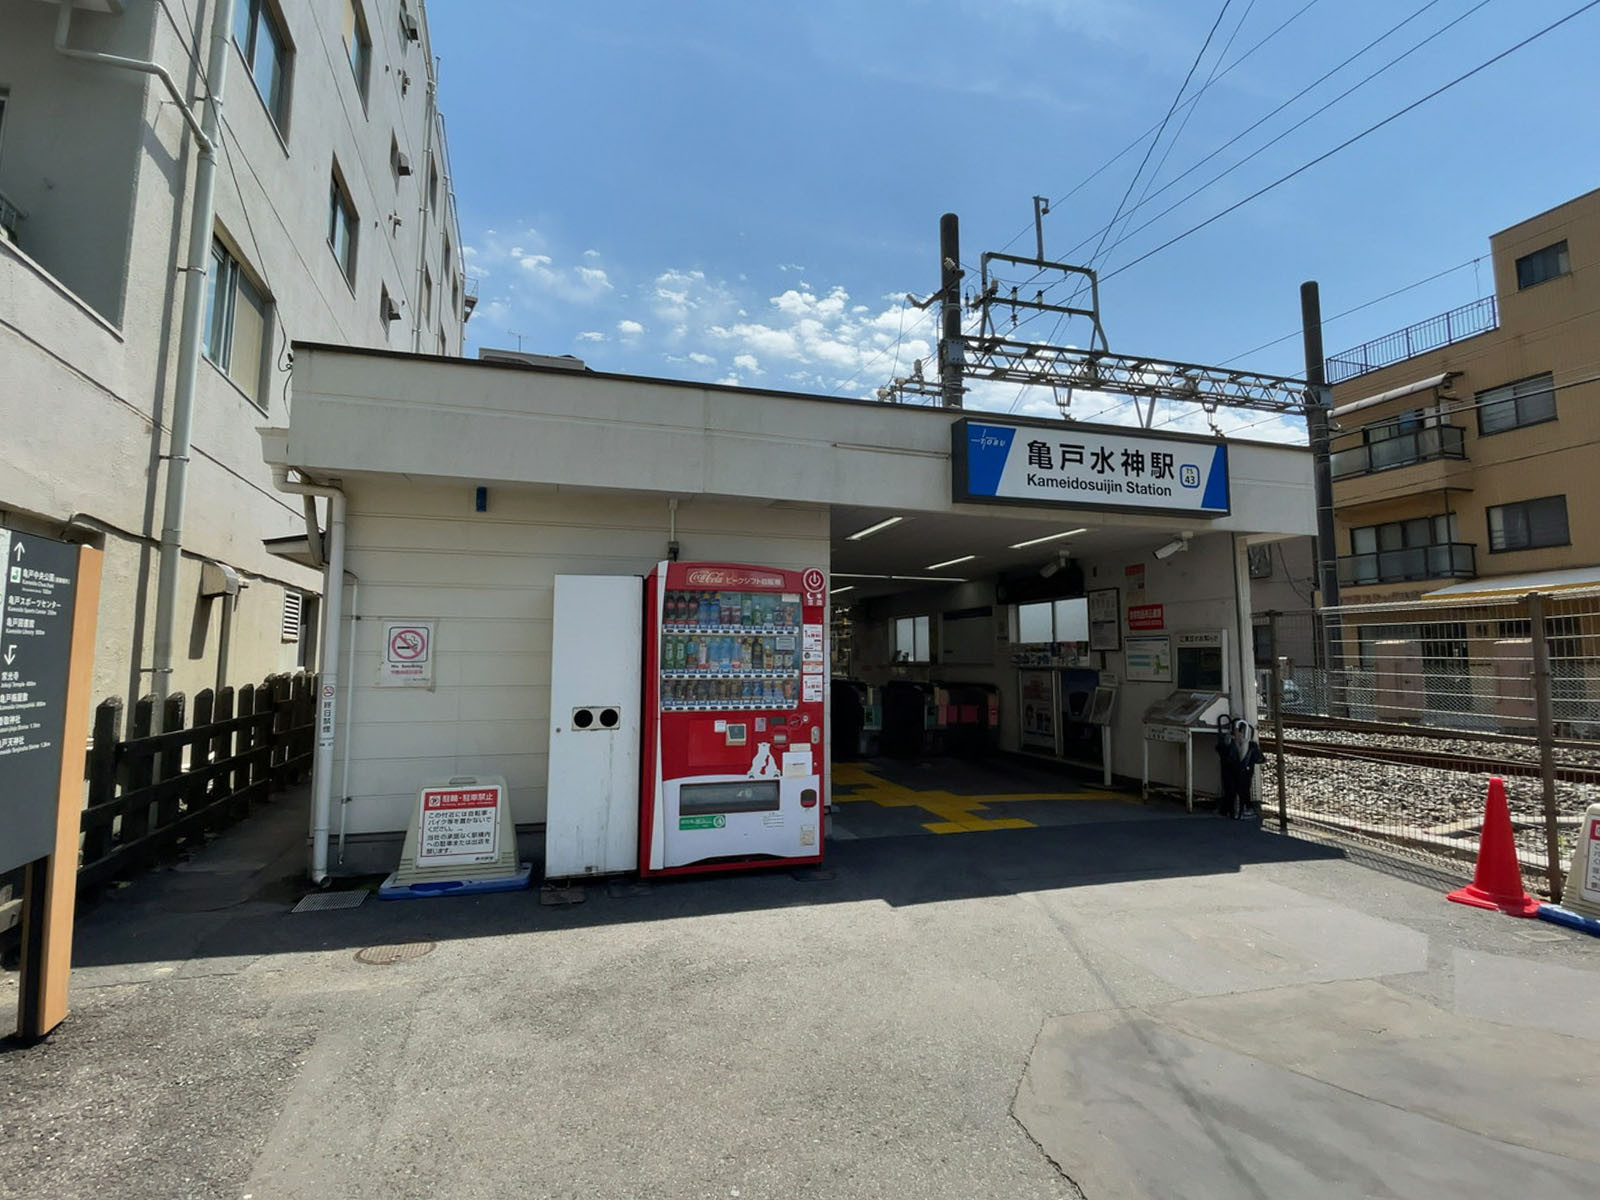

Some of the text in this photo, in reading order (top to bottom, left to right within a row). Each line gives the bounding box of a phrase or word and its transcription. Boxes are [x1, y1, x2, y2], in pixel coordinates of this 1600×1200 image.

[1027, 440, 1175, 480] 亀戸水神駅
[1027, 473, 1172, 497] Kameidosuijin Station
[1184, 475, 1196, 484] 43
[8, 595, 61, 608] 亀戸スポーツセンター
